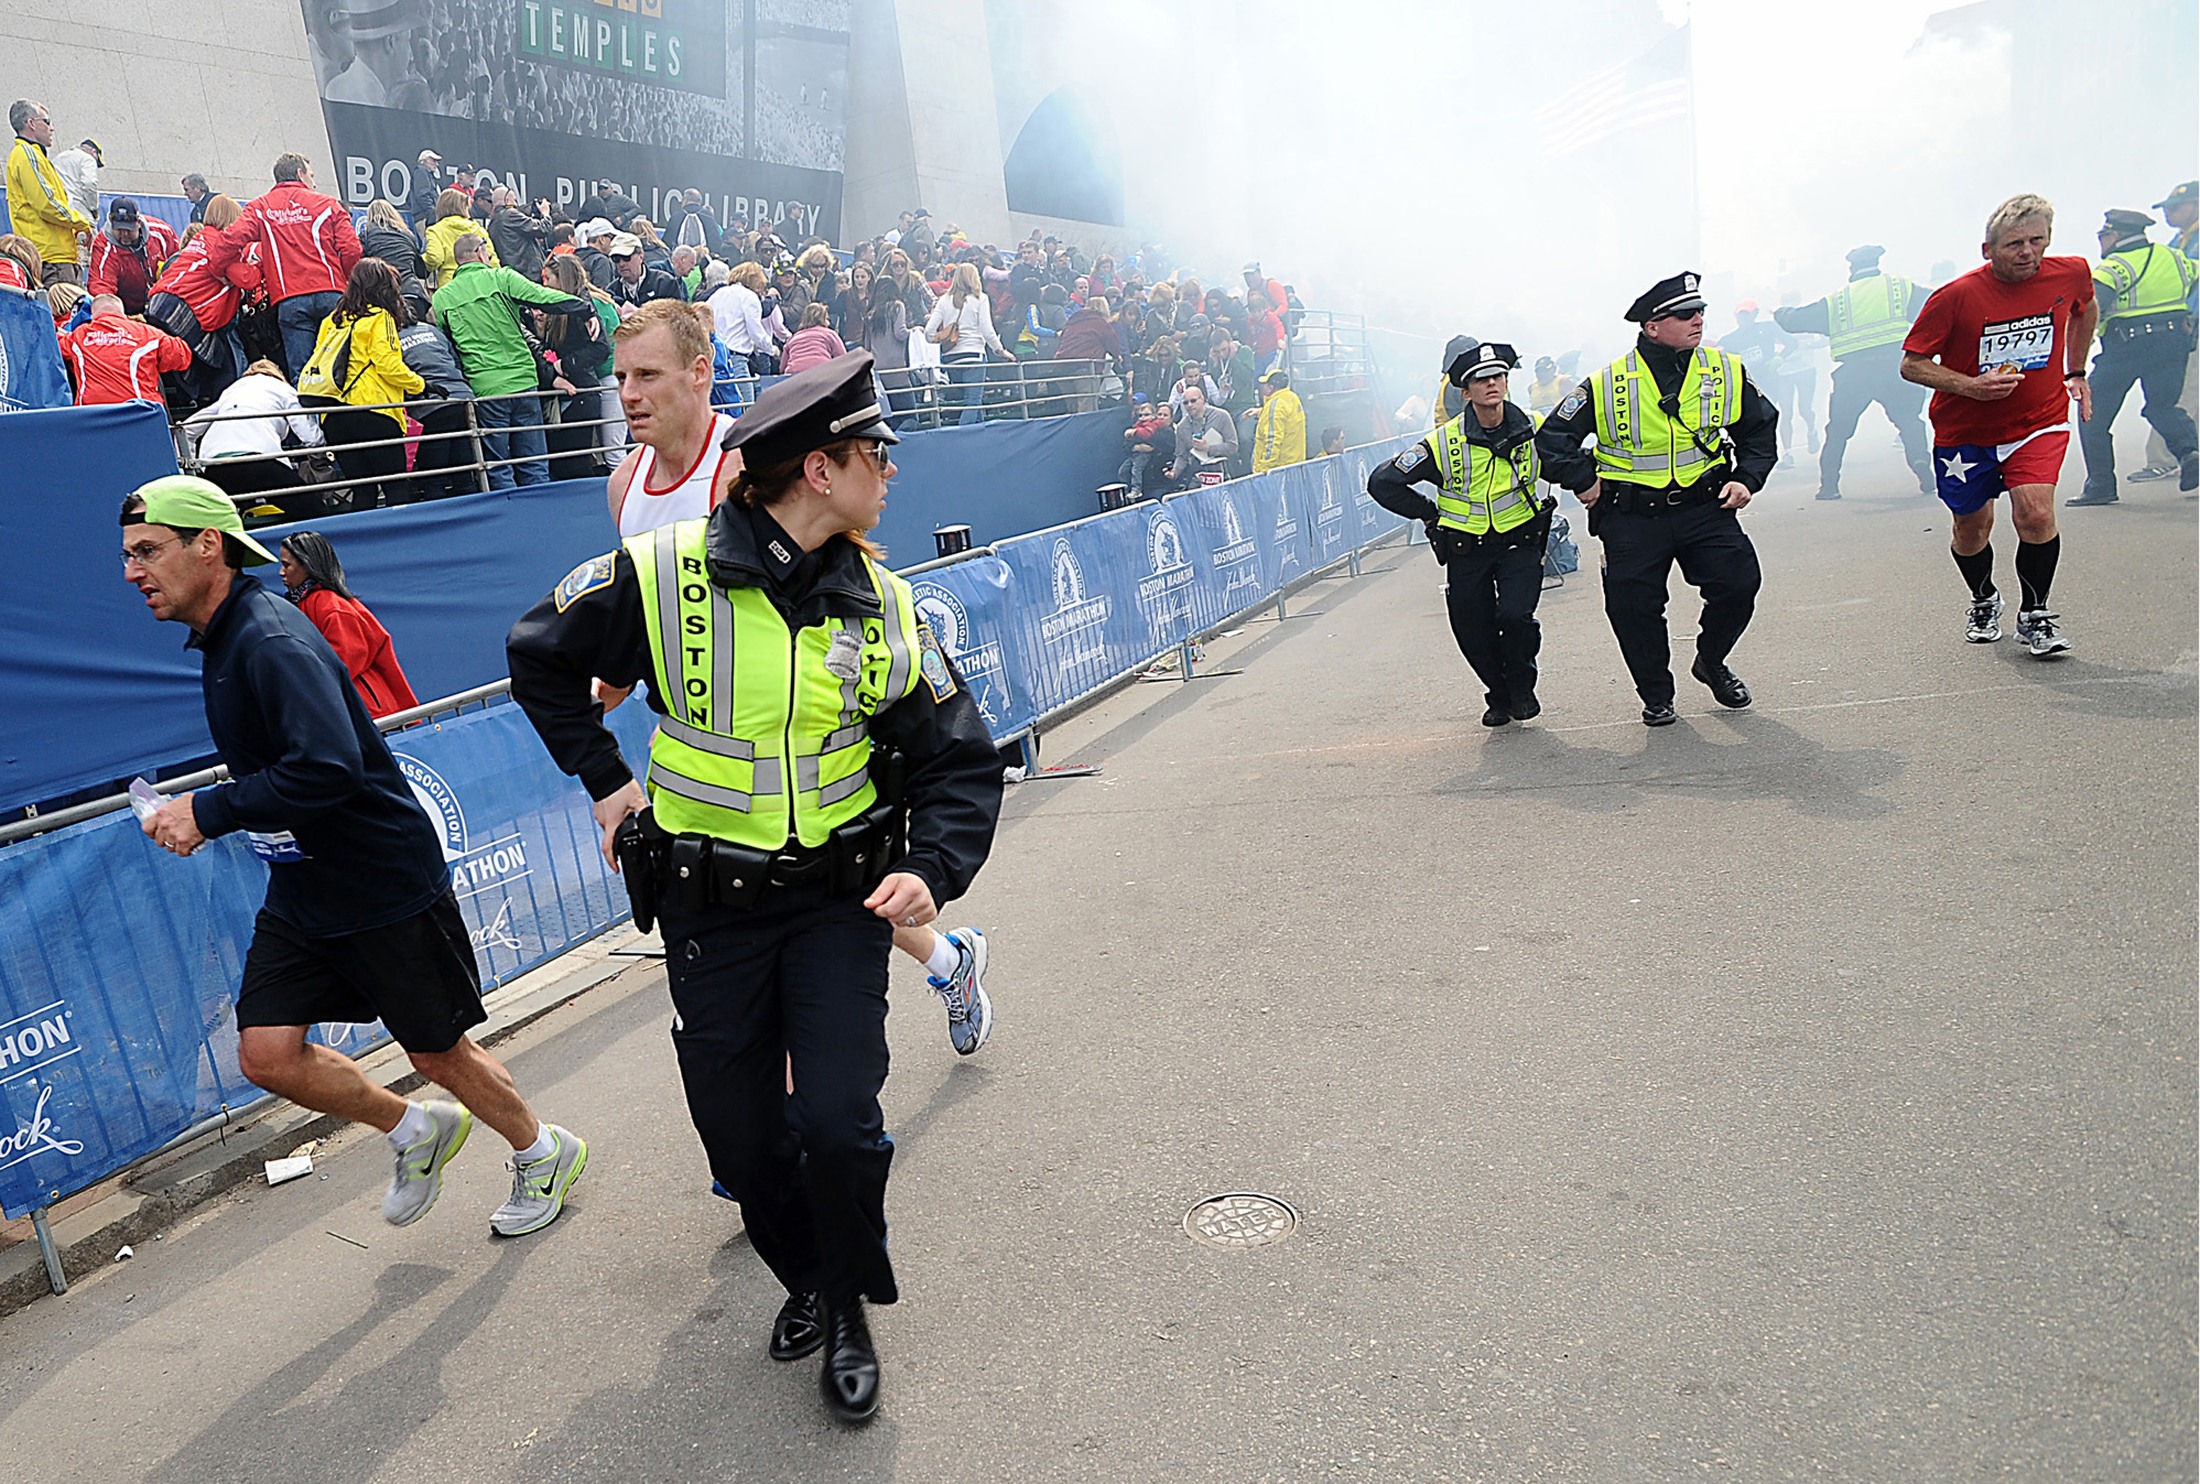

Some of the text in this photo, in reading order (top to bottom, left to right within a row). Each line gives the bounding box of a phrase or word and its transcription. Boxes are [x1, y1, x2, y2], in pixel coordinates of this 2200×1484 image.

[525, 1, 681, 77] TEMPLES
[346, 156, 528, 206] BOON
[1984, 327, 2052, 353] 19797
[2010, 316, 2051, 330] adidas
[1614, 374, 1631, 441] BOSTON
[1449, 437, 1463, 492] BOSTON
[683, 556, 708, 727] BOSTON
[932, 588, 966, 645] ASSOCIATION
[1042, 601, 1106, 639] BOSTON MARATHON
[400, 761, 462, 843] ASSOCIATION
[452, 845, 526, 890] ATHON
[0, 1014, 71, 1070] HON
[1198, 1207, 1281, 1237] WATER
